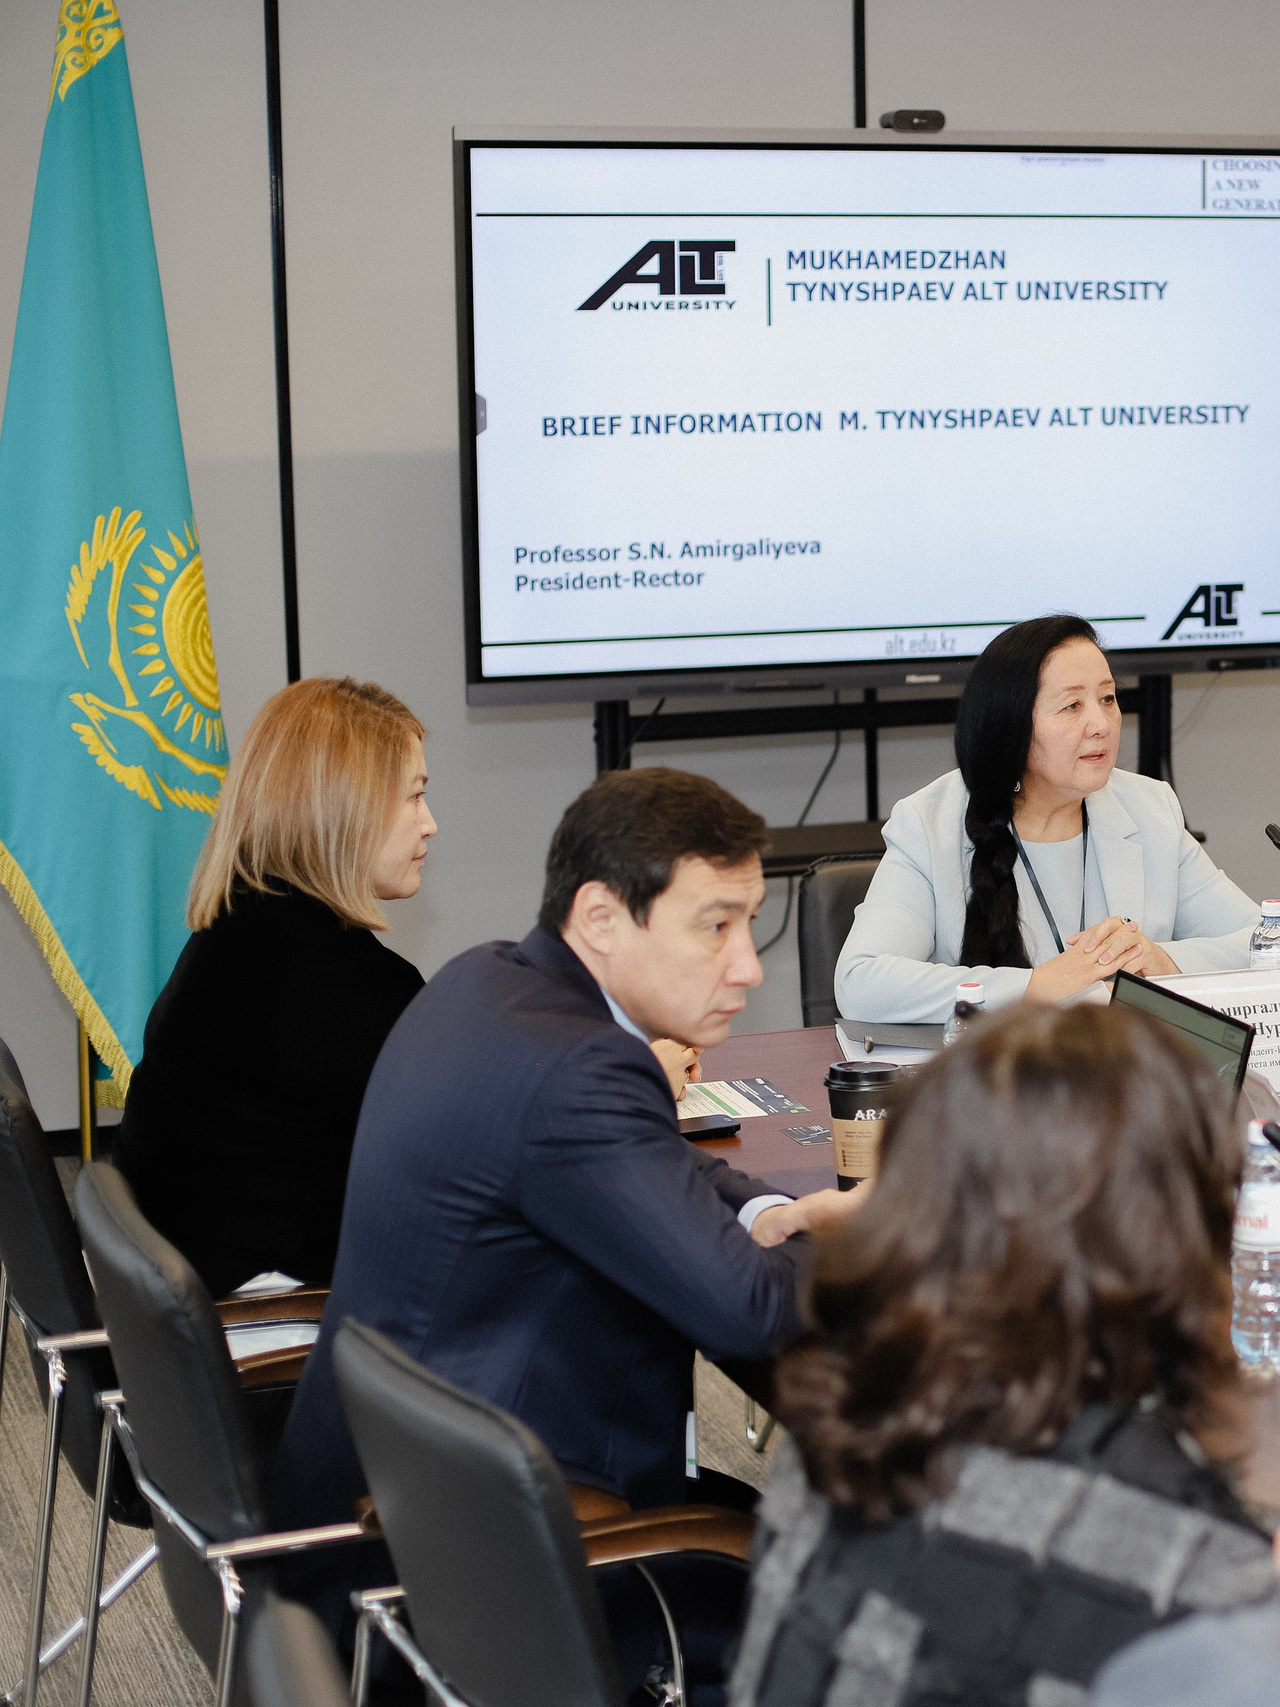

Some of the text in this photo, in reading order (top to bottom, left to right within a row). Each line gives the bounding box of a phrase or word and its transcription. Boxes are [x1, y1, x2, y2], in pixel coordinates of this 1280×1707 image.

[1212, 178, 1261, 192] A NEW
[787, 250, 1006, 270] MUKHAMEDZHAN
[575, 240, 736, 311] ALT
[787, 281, 1168, 301] TYNYSHPAEV ALT UNIVERSITY
[612, 300, 736, 311] UNIVERSITY
[542, 404, 1250, 437] BRIEF INFORMATION M. TYNYSHPAEV ALT UNIVERSITY
[515, 538, 822, 564] Professor S.N. Amirgaliyeva
[516, 569, 705, 591] President-Rector
[1160, 583, 1244, 641] ALT
